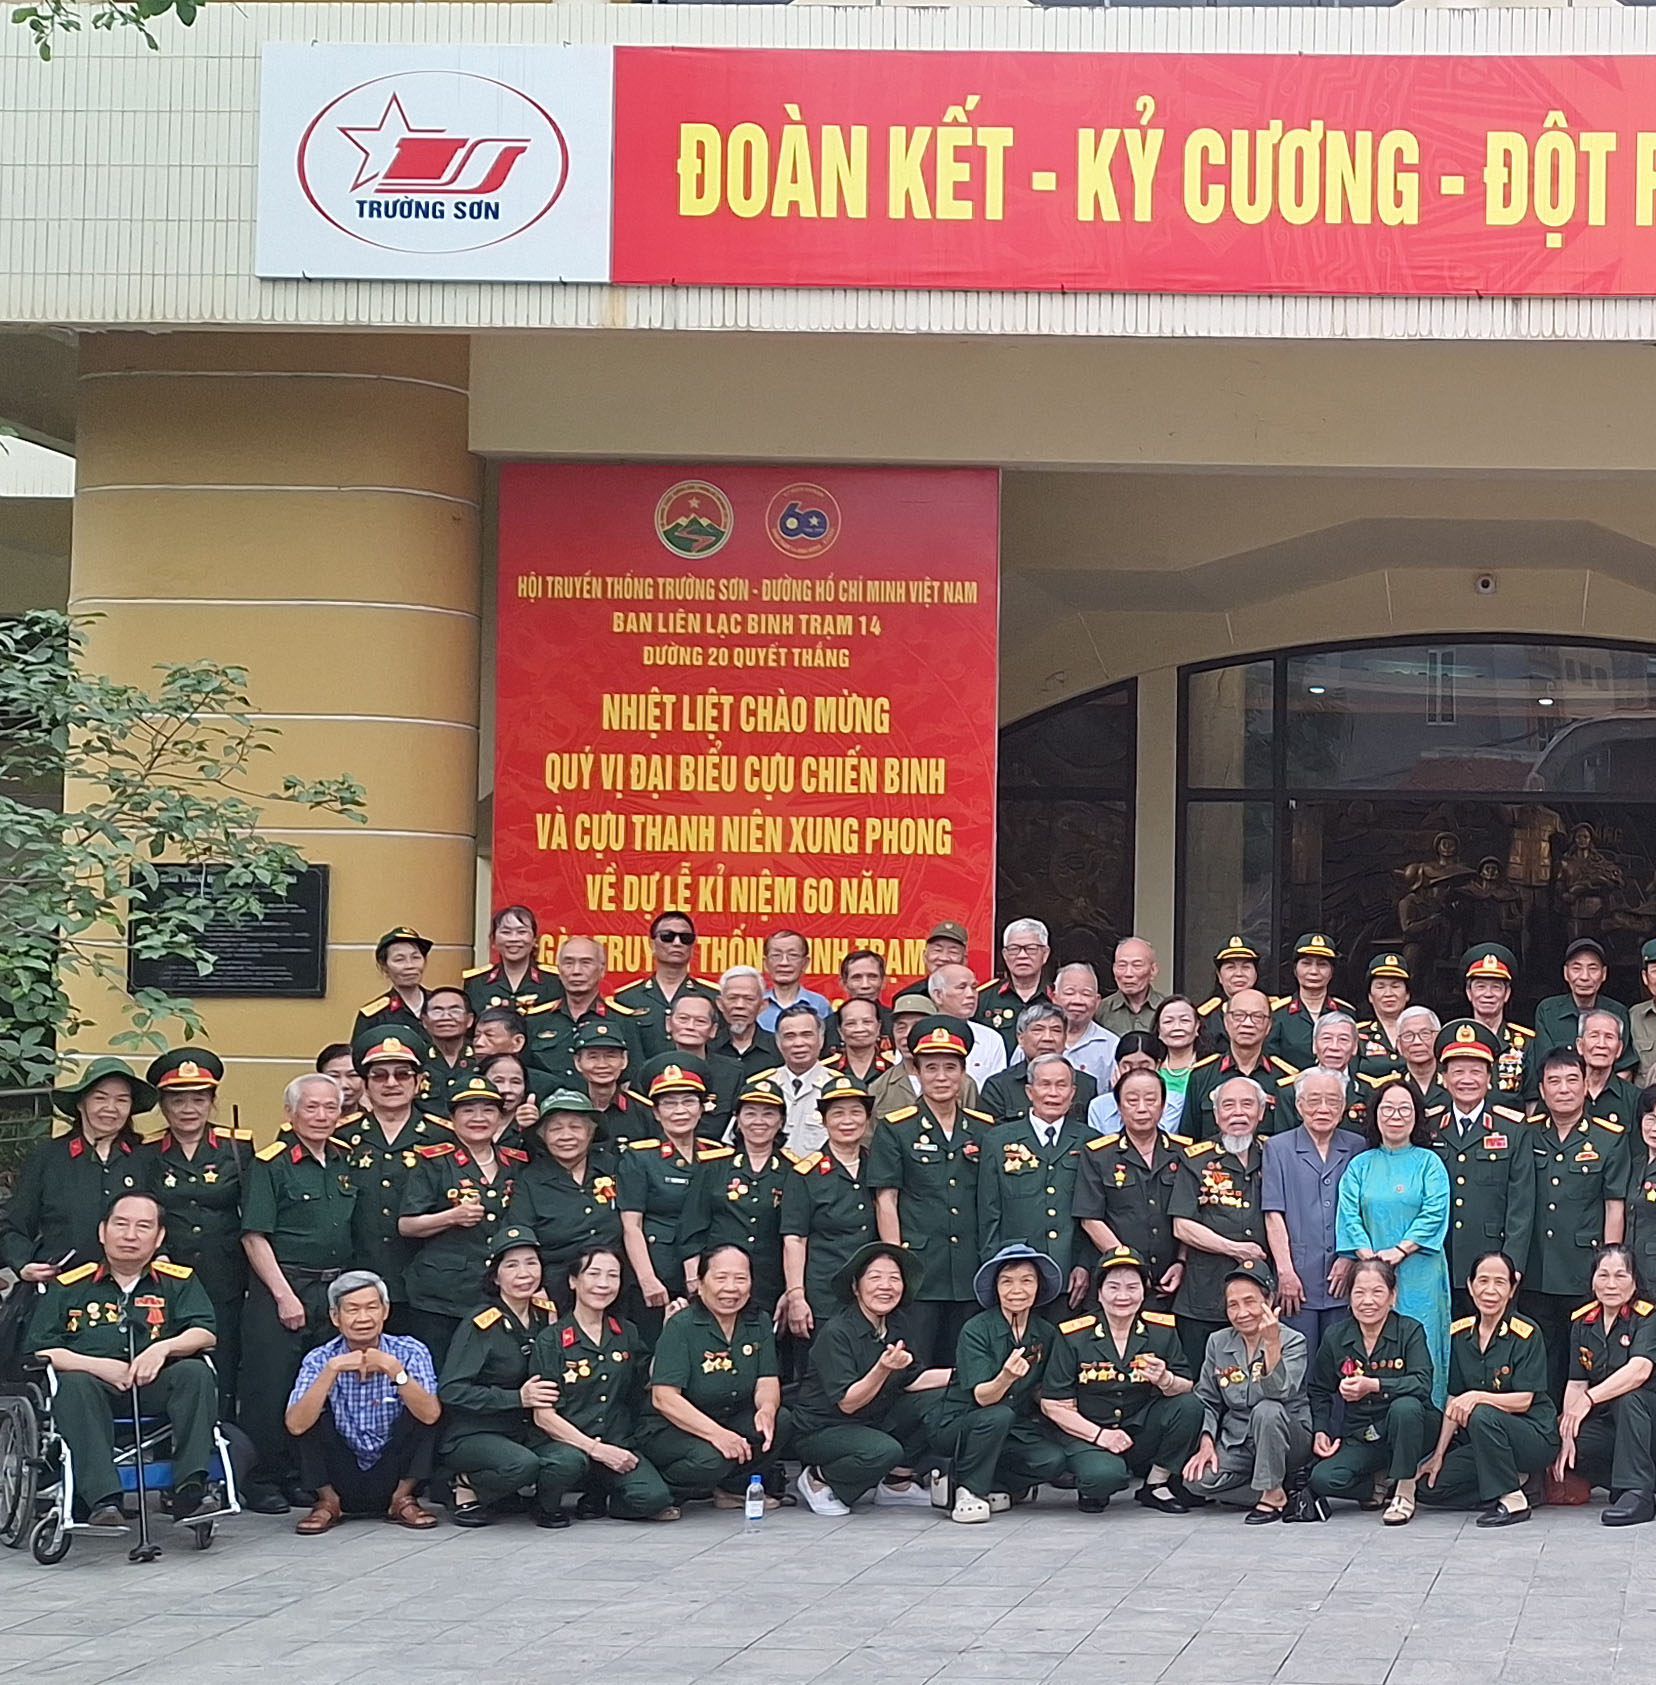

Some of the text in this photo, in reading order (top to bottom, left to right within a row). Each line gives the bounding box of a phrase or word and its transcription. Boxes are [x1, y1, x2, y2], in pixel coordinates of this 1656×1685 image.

[677, 104, 867, 218] ĐOÀN
[889, 95, 1013, 220] KẾT
[1033, 172, 1056, 190] -
[1078, 95, 1164, 221] KỶ
[1184, 120, 1419, 225] CƯƠNG
[1441, 176, 1464, 194] -
[1484, 111, 1616, 247] ĐỘT
[356, 196, 499, 219] TRƯỜNG SƠN
[518, 572, 542, 602] HỘI
[546, 571, 601, 598] TRUYỀN
[606, 570, 653, 599] THỐNG
[657, 573, 715, 600] TRƯỜNG
[719, 578, 748, 600] SƠN
[762, 574, 811, 601] ĐƯỜNG
[816, 573, 834, 601] HỒ
[839, 577, 862, 602] CHÍ
[867, 581, 905, 602] MINH
[909, 577, 940, 607] VIỆT
[944, 582, 977, 603] NAM
[613, 609, 881, 643] BAN LIÊN LẠC BINH TRẠM 14
[644, 642, 849, 668] ĐƯỜNG 20 QUYẾT THẮNG
[603, 687, 889, 742] NHIỆT LIỆT CHÀO MỪNG
[546, 738, 945, 800] QUÝ VỊ ĐẠI BIỂU CỰU CHIẾN BINH
[536, 806, 951, 858] VÀ CỰU THANH NIÊN XUNG PHONG
[587, 862, 898, 921] VỀ DỰ LỄ KỈ NIỆM 60 NĂM
[696, 922, 764, 974] THỐN
[805, 938, 849, 975] INH
